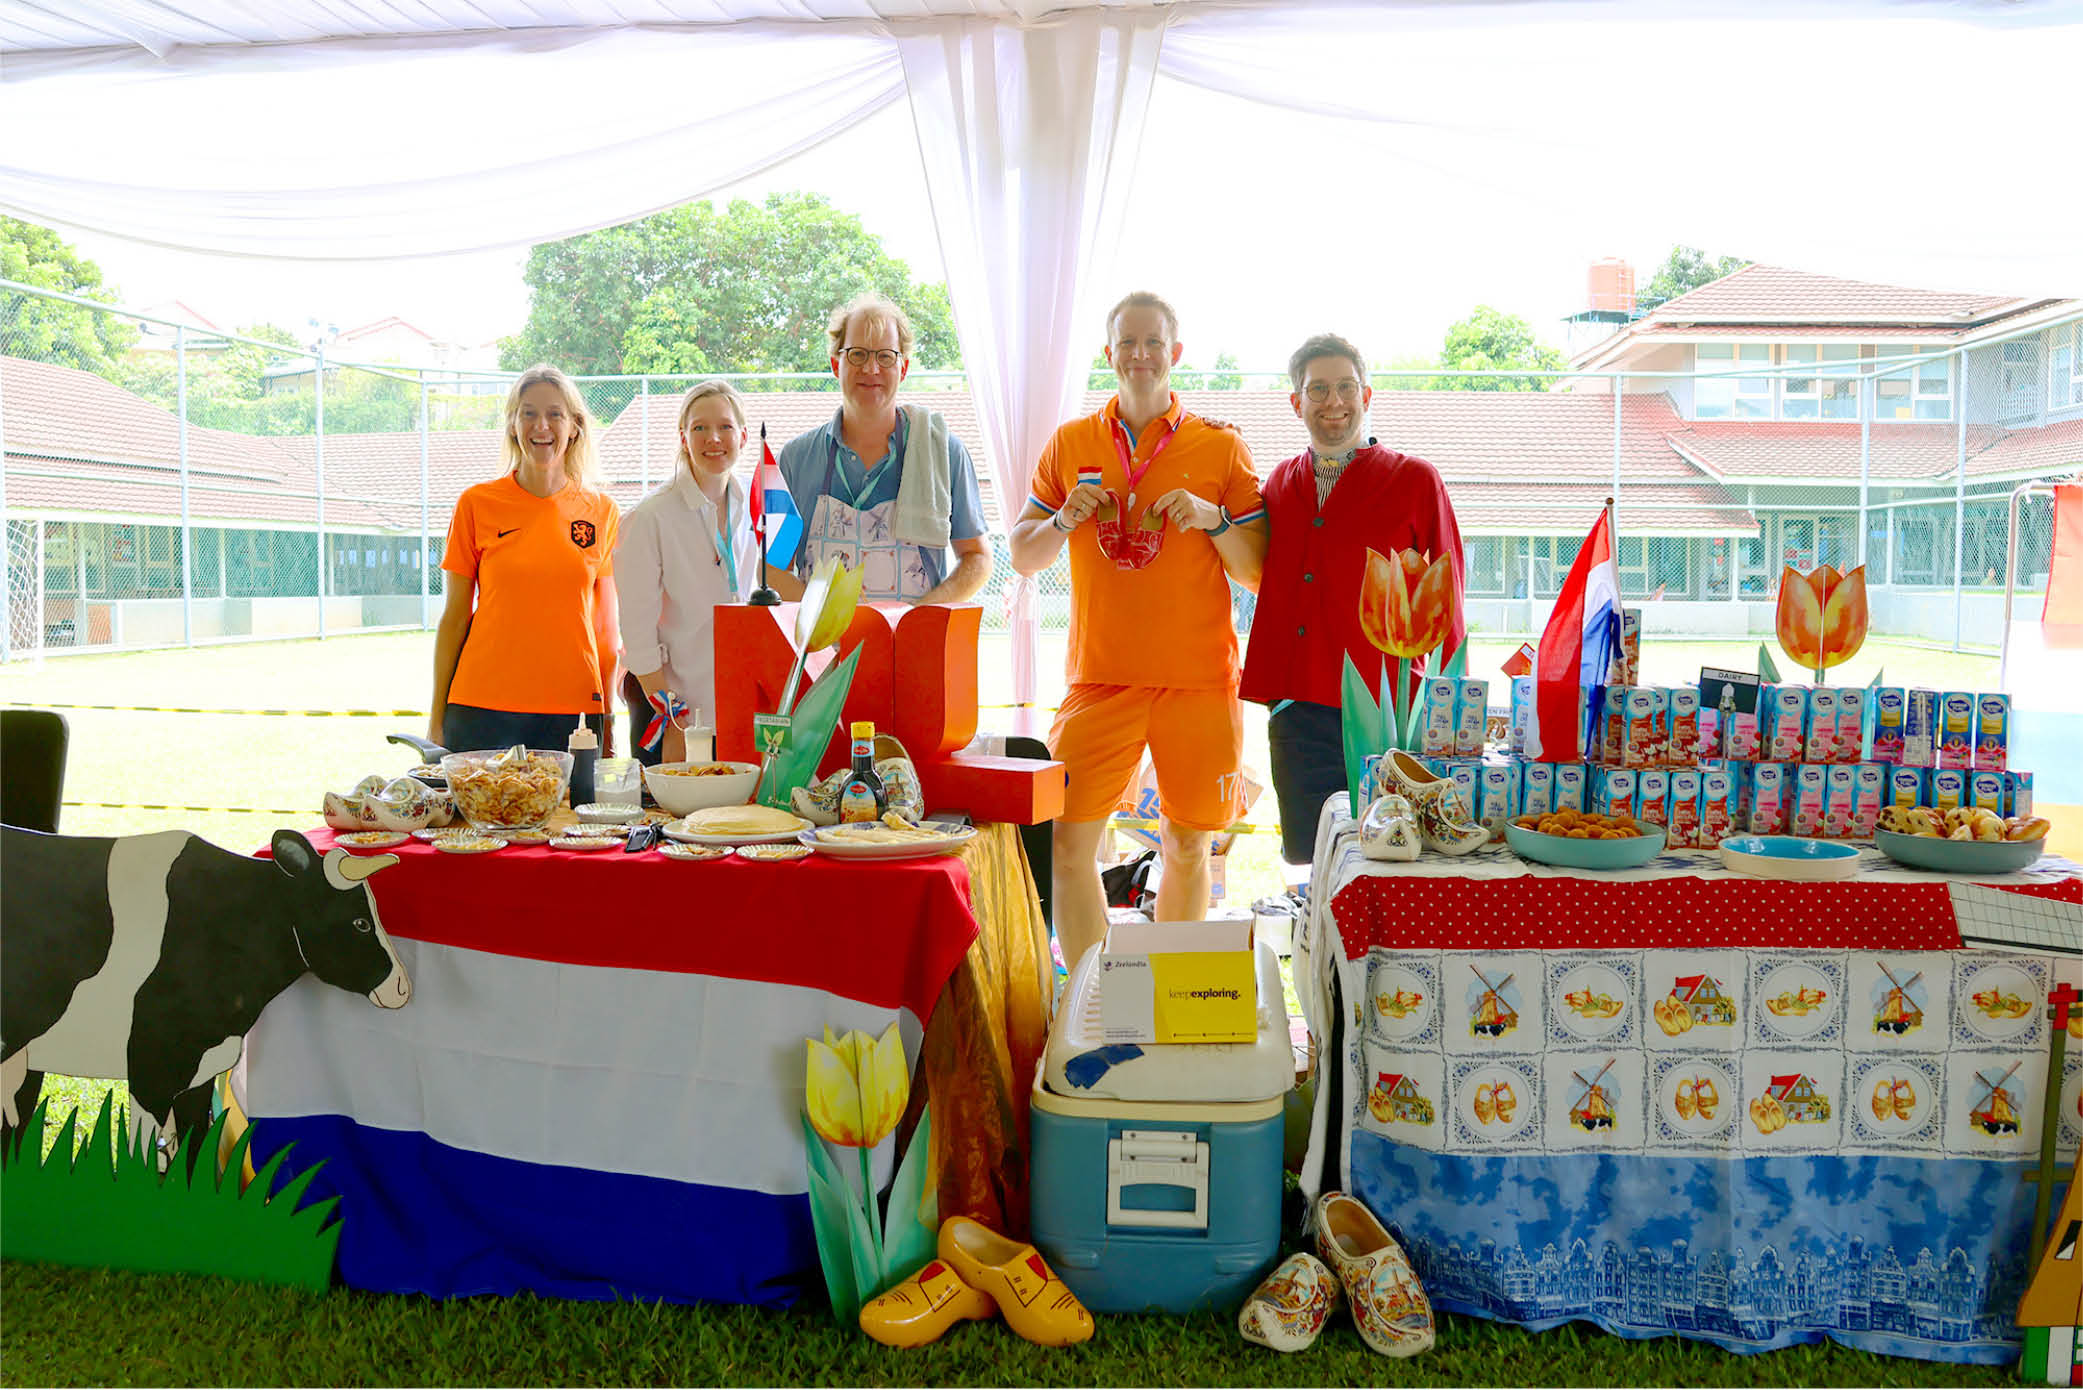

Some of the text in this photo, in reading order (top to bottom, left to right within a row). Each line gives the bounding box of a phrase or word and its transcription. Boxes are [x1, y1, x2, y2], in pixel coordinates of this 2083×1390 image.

[1718, 672, 1743, 681] DAIRY
[1216, 772, 1240, 803] 17
[1115, 960, 1147, 968] Zeelandia
